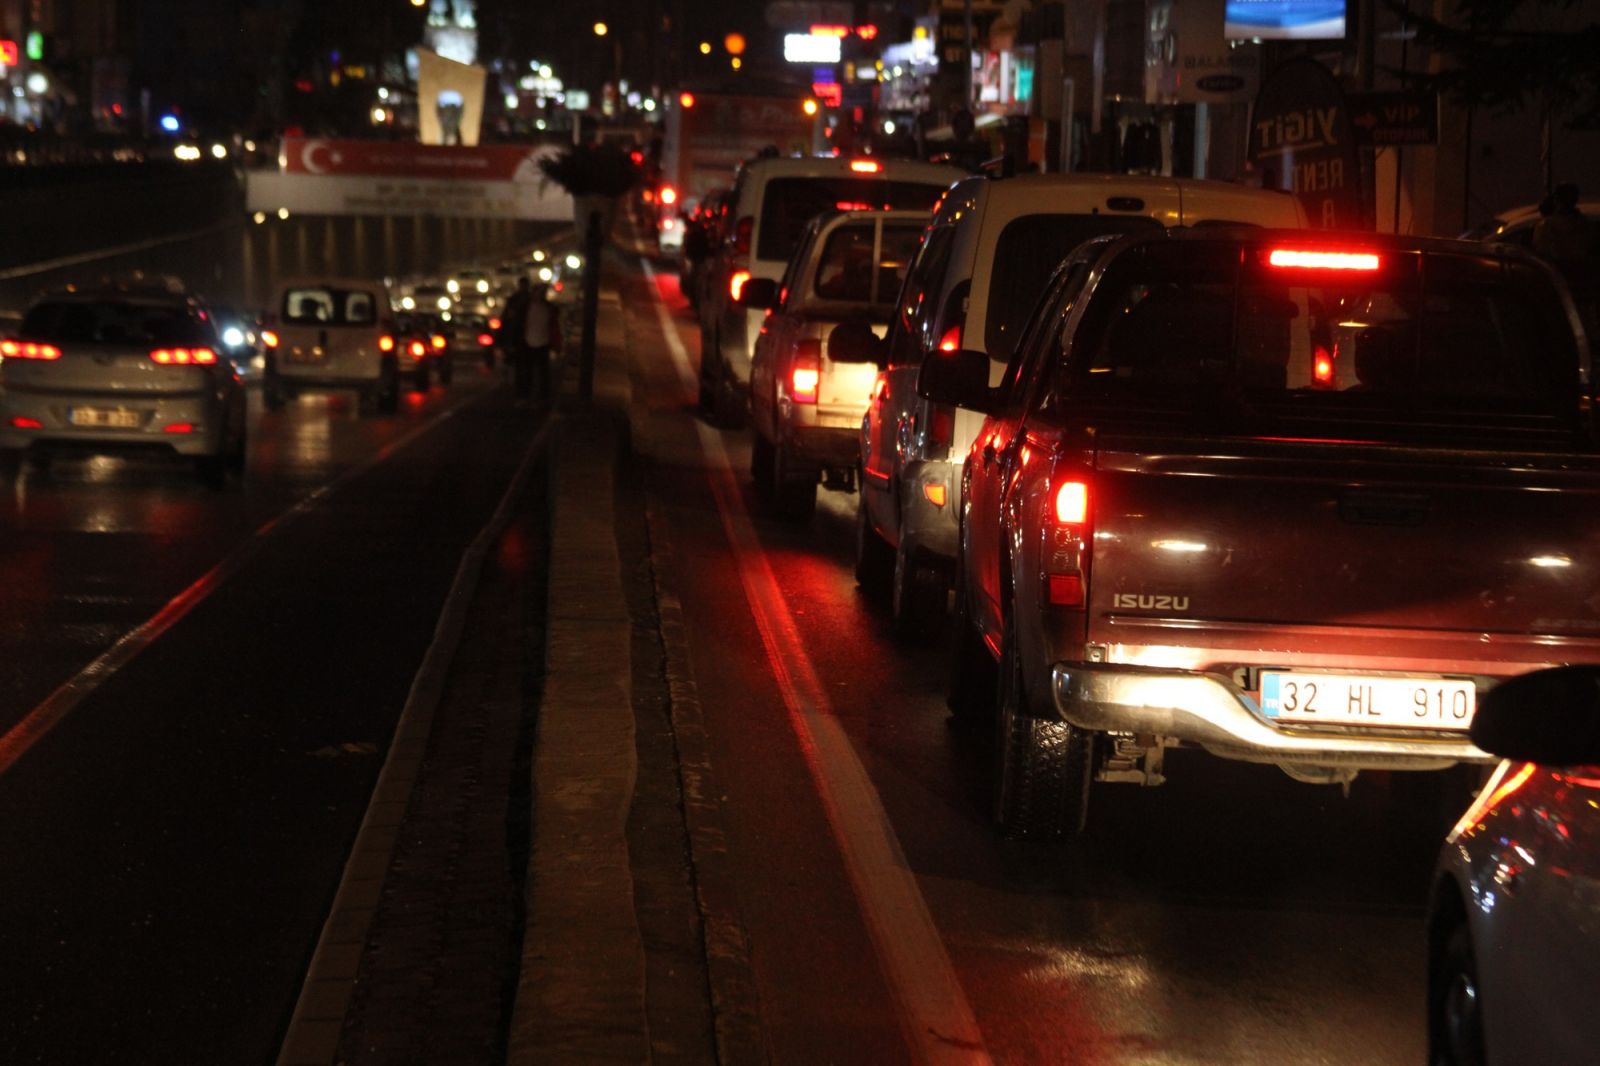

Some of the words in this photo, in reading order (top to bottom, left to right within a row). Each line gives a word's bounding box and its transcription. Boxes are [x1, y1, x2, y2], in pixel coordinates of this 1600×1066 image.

[1383, 103, 1421, 123] VIP
[1113, 593, 1190, 611] ISUZU
[1283, 681, 1318, 714] 32
[1347, 684, 1381, 716] HL
[1413, 687, 1467, 720] 910
